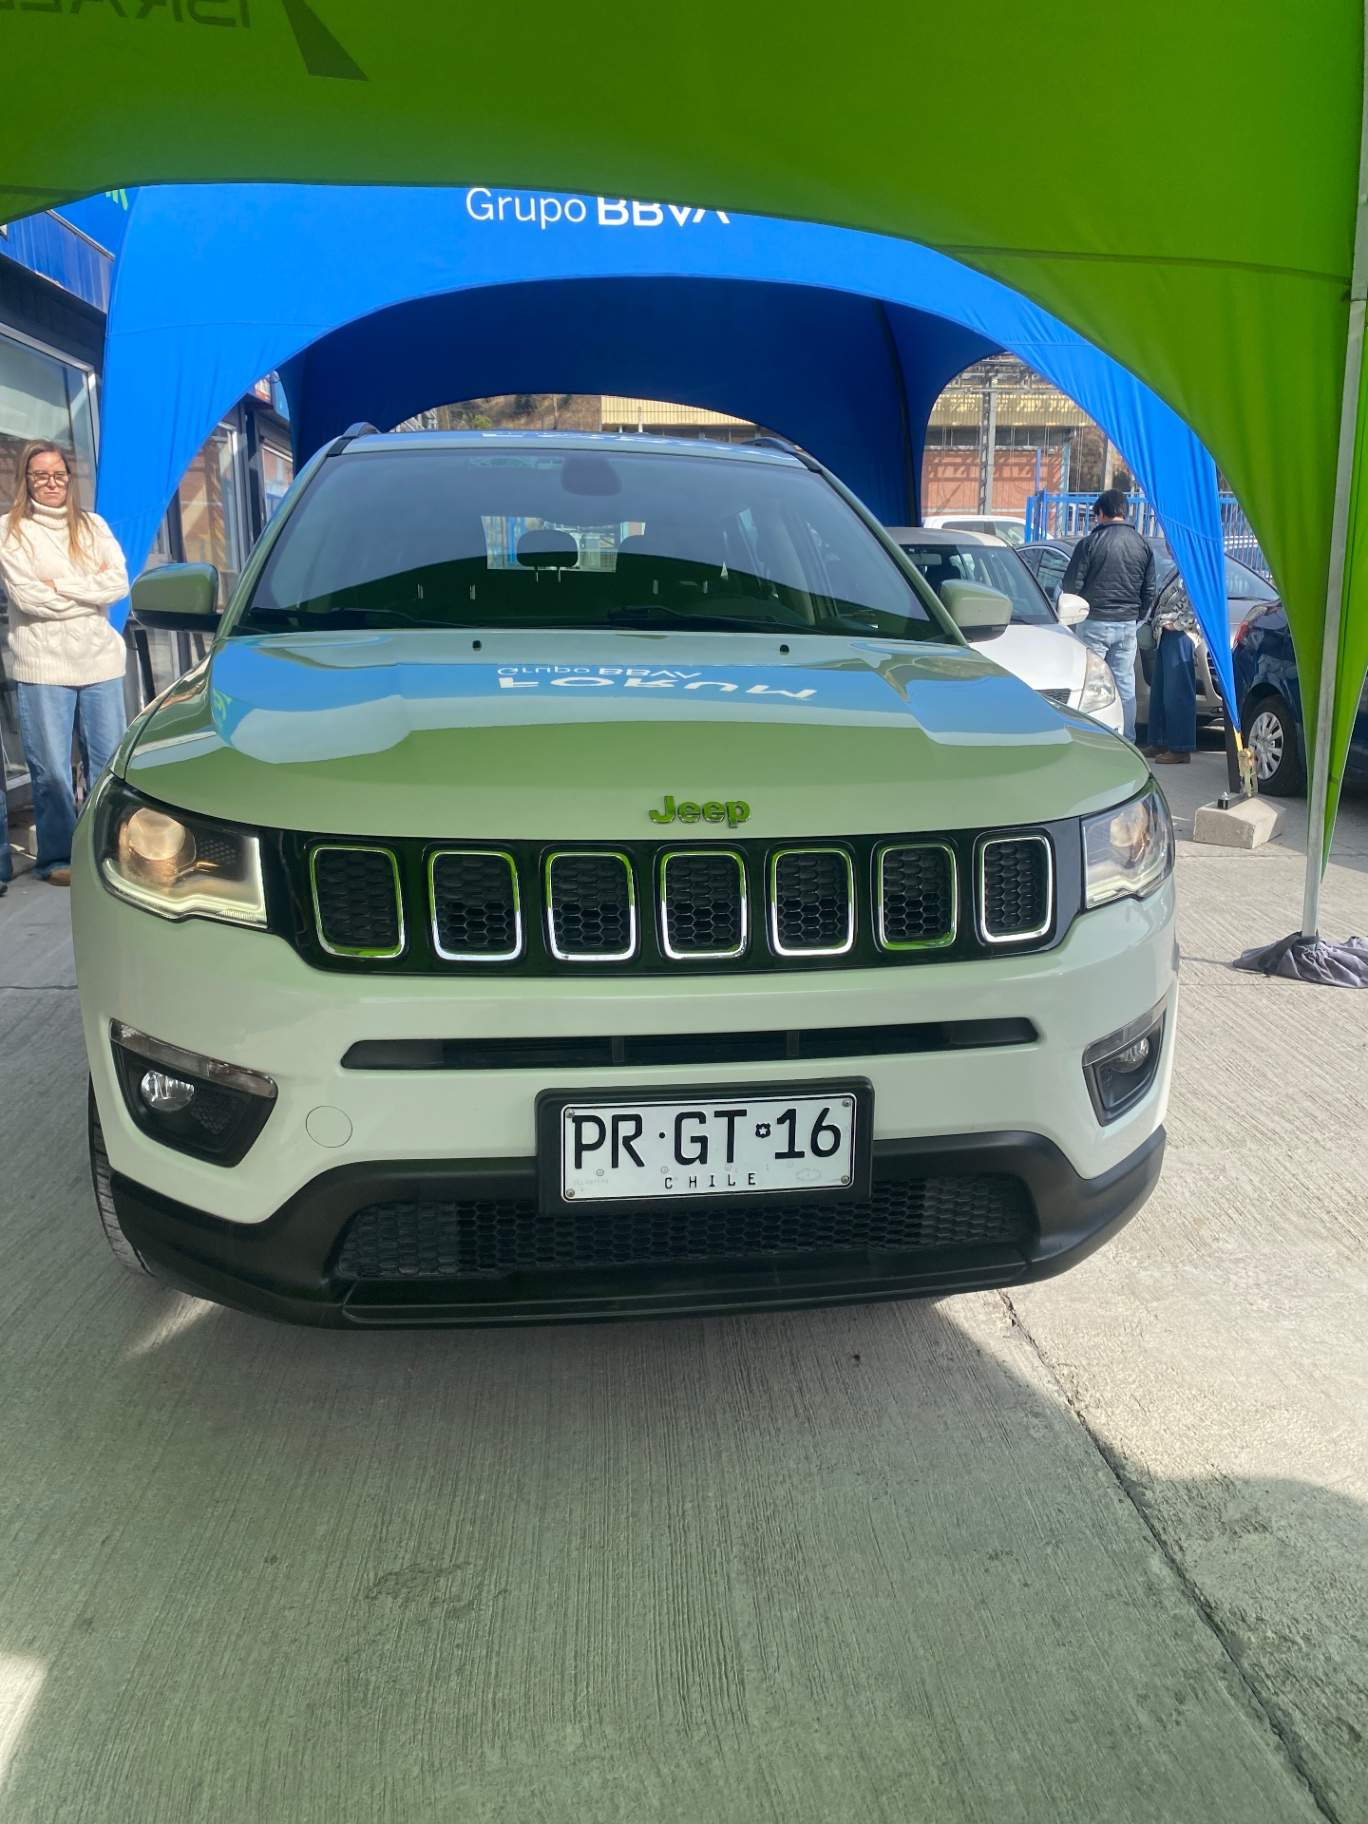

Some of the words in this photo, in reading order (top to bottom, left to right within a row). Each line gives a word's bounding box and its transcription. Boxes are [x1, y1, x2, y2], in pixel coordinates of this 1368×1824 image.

[466, 187, 587, 230] Grupo
[648, 795, 751, 829] Jeep
[664, 1172, 757, 1190] CHILE
